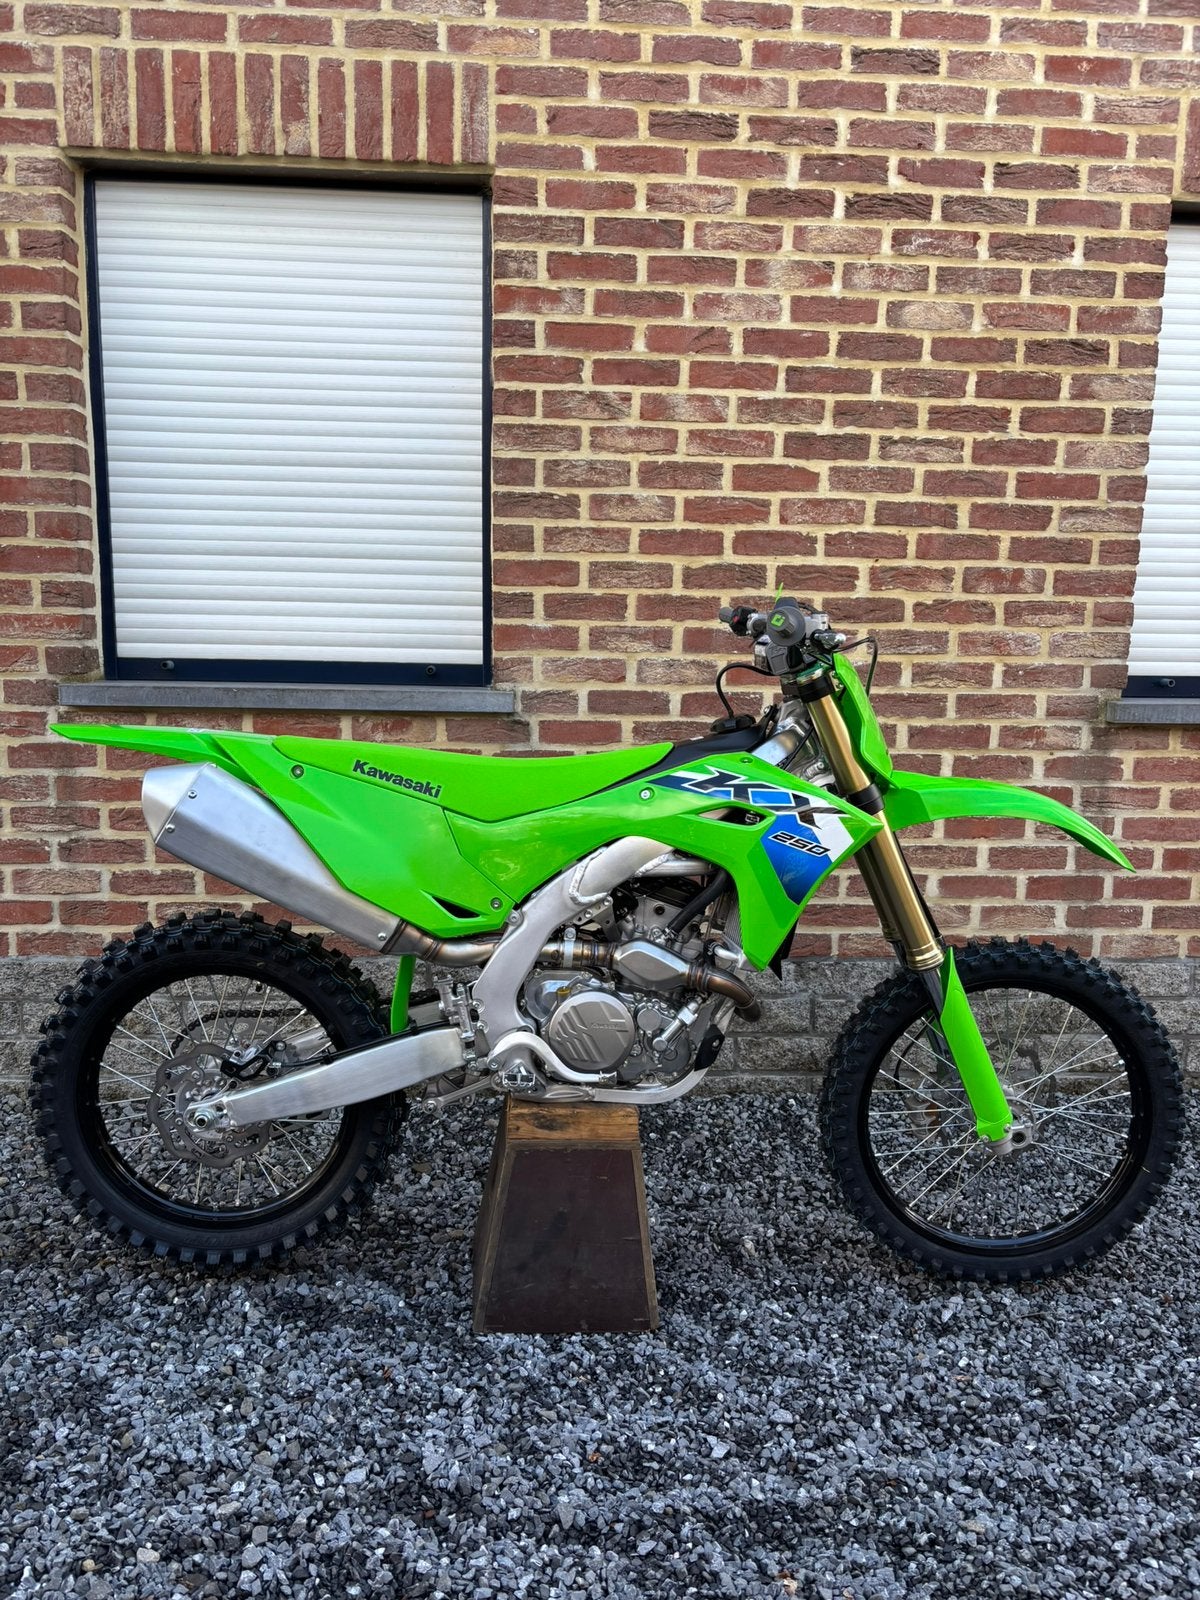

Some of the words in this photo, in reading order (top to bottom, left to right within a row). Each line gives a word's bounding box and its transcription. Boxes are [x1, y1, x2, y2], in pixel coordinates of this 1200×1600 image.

[353, 759, 441, 798] Kawasaki
[683, 766, 849, 830] KX
[770, 831, 831, 856] 250
